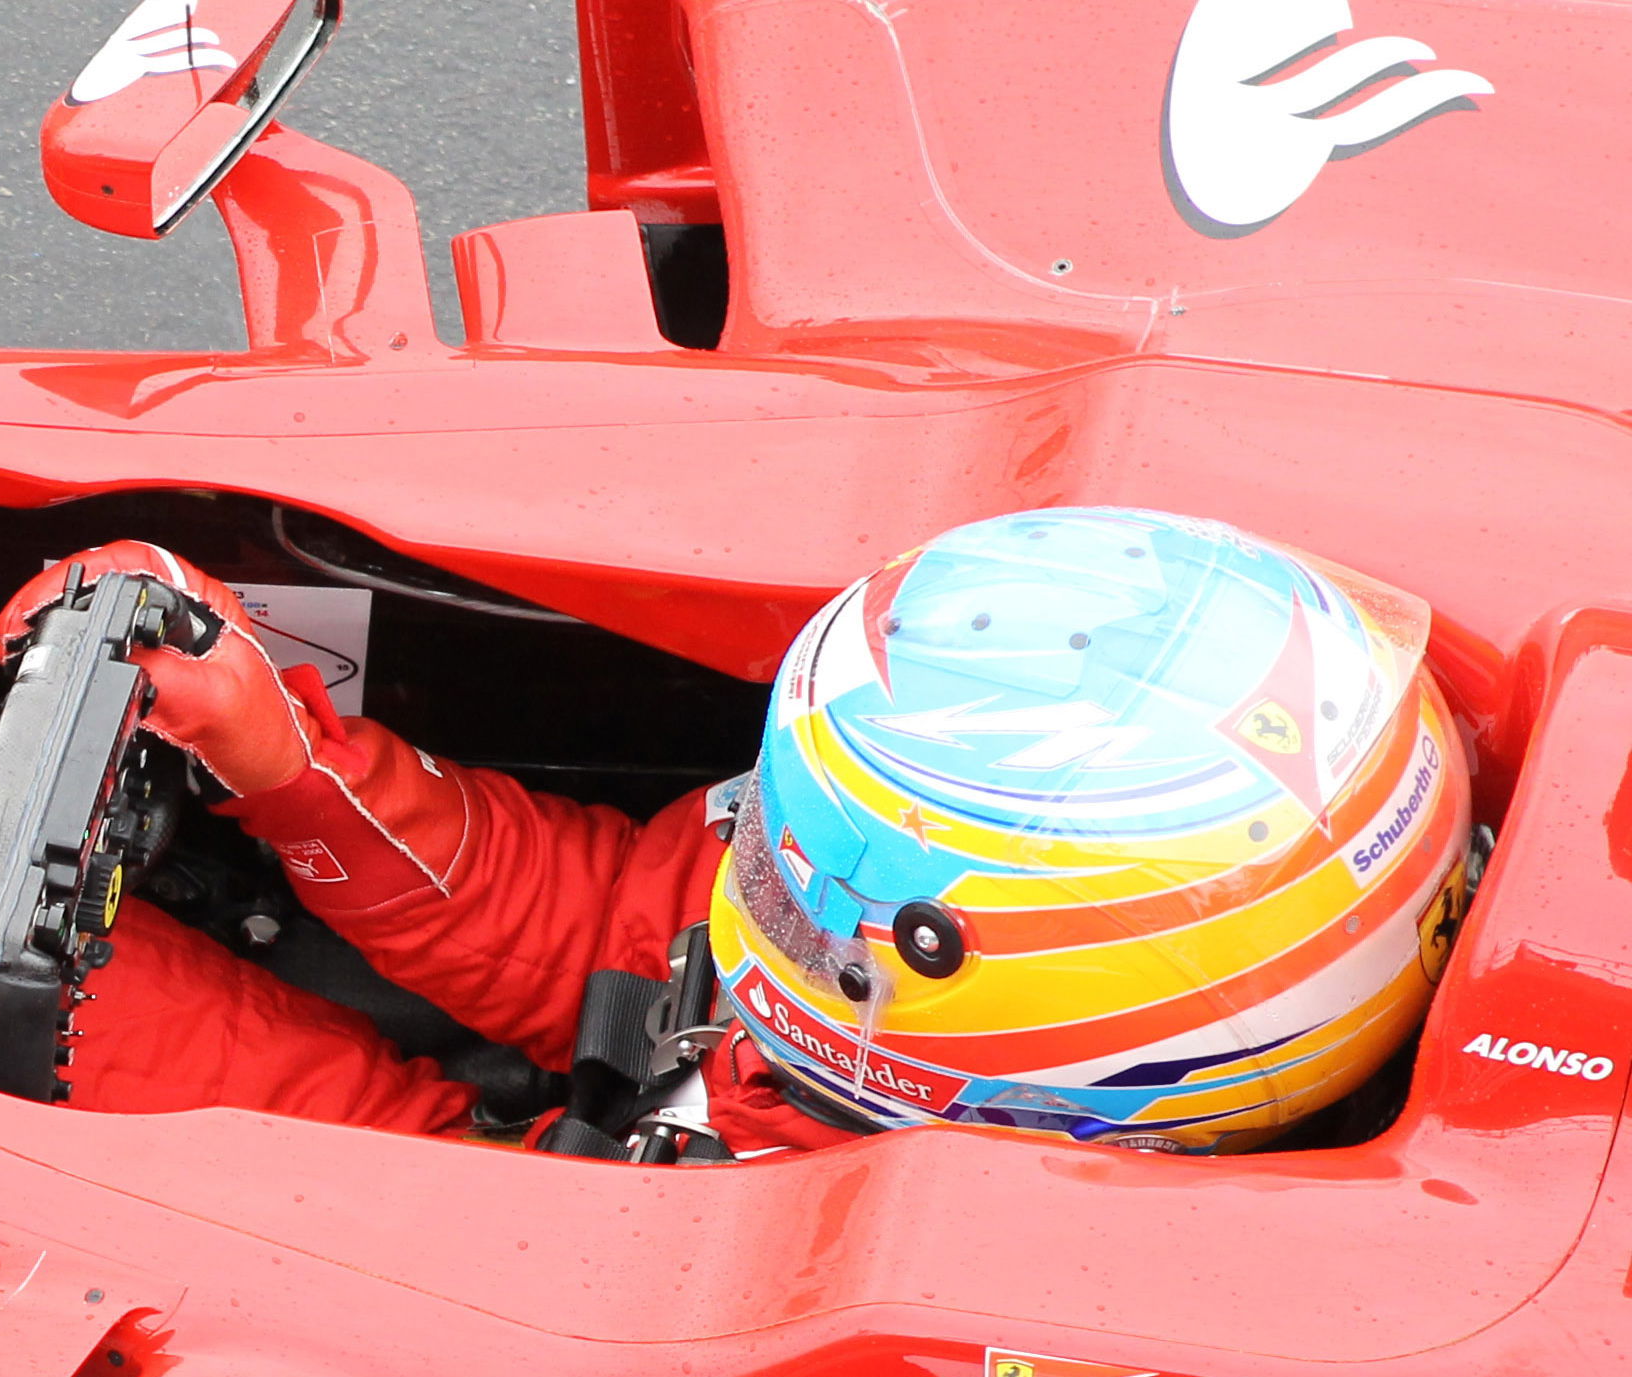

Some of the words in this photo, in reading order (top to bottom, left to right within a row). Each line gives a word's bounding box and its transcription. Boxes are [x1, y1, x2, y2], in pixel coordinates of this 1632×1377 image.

[1353, 766, 1433, 873] Schuberth
[774, 1002, 933, 1101] Santander
[1462, 1033, 1614, 1081] ALONSO
